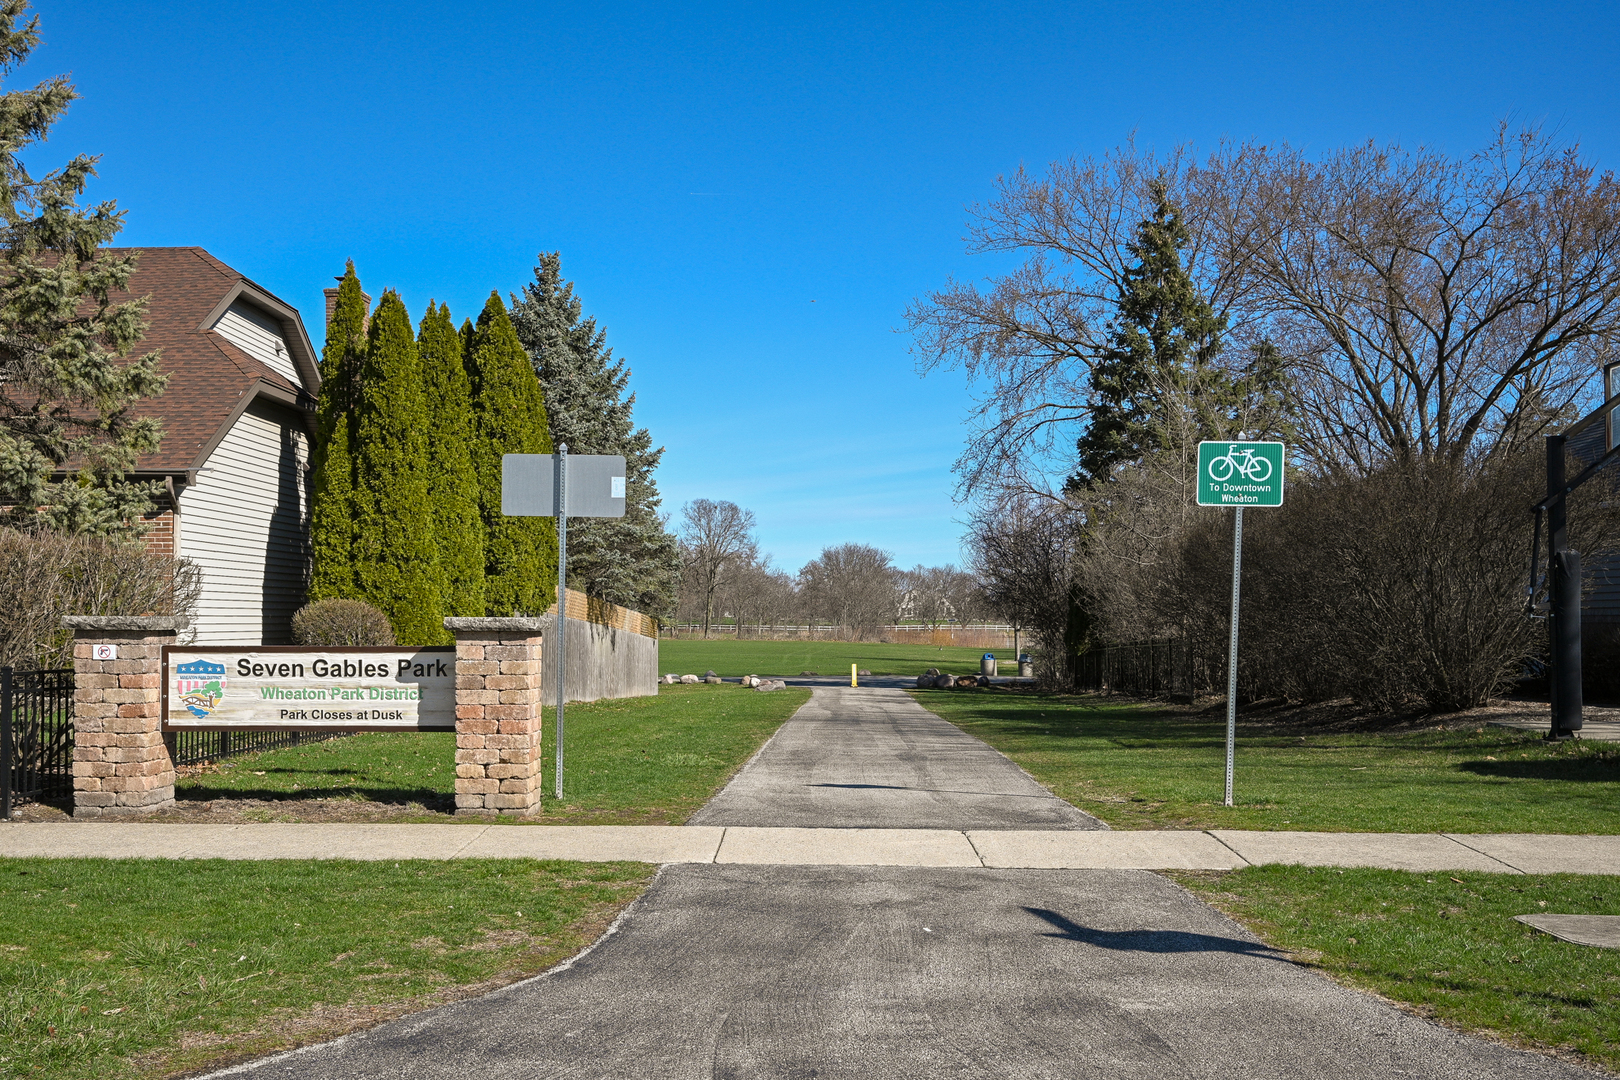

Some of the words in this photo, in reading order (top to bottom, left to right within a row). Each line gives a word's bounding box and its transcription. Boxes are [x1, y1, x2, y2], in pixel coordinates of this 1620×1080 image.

[1209, 483, 1220, 492] To
[1223, 483, 1271, 492] Downtown
[1221, 494, 1258, 503] Wheaton
[237, 658, 304, 677] Seven
[312, 658, 389, 677] Gables
[398, 659, 448, 677] Park
[261, 686, 326, 700] Wheaton
[331, 687, 365, 700] Park
[370, 687, 423, 700] District
[280, 709, 308, 720] Park
[311, 709, 352, 720] Closes
[357, 710, 368, 720] at
[372, 709, 403, 720] Dusk
